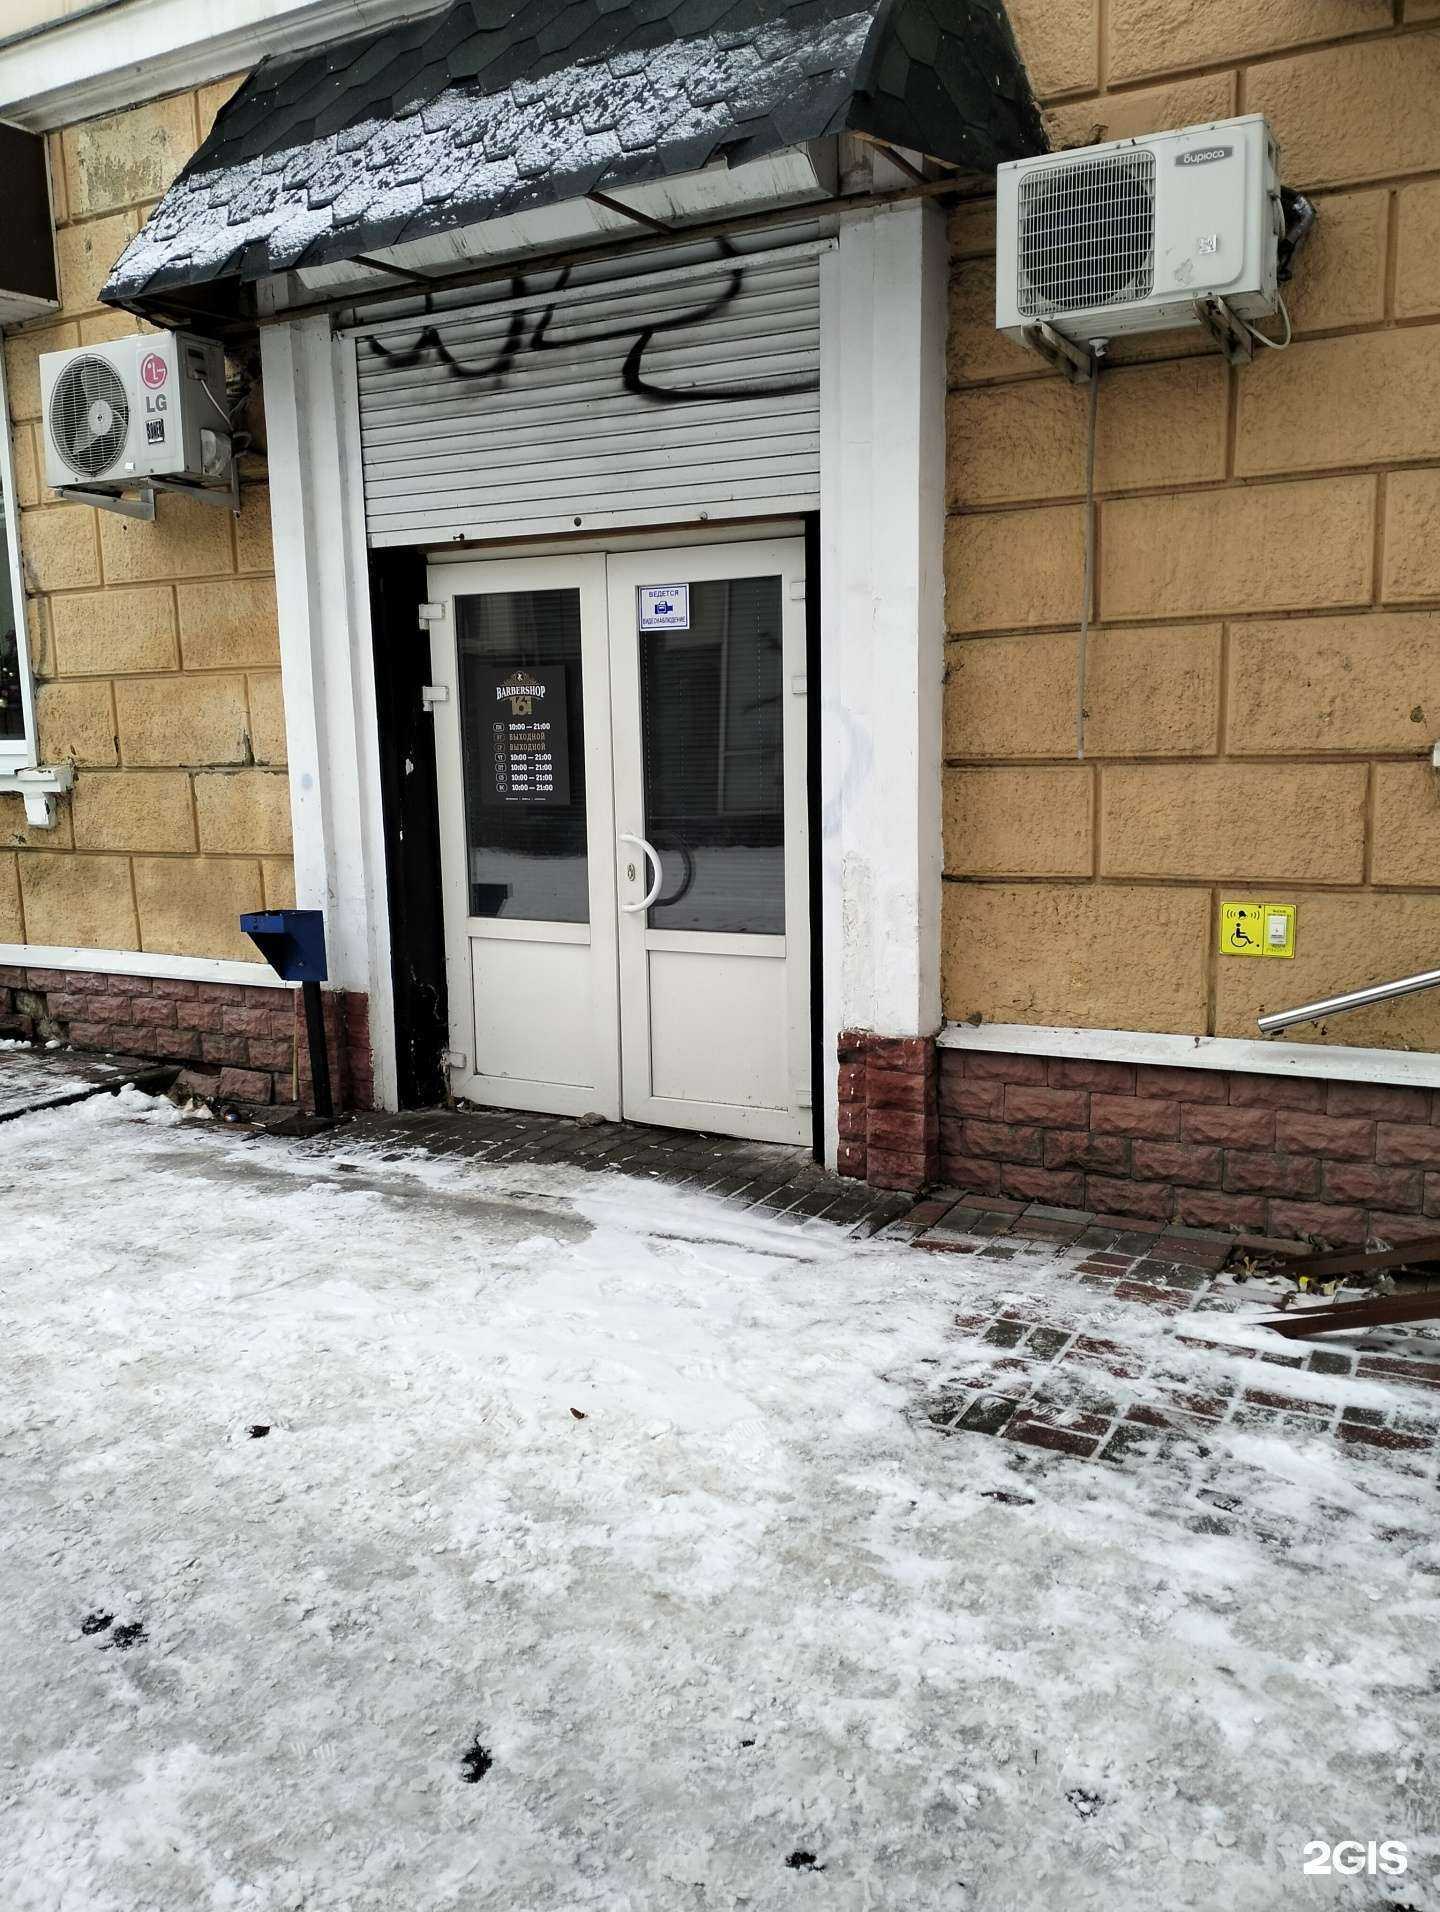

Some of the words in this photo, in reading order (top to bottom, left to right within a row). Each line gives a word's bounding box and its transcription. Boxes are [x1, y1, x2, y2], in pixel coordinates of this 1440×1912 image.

[145, 393, 168, 413] LG
[648, 590, 679, 598] ВЕДЕТСЯ
[496, 685, 546, 701] BARBERSHOP
[508, 723, 526, 731] 10:00
[533, 722, 551, 730] 21:00
[509, 732, 546, 742] ВЫХОДНОЙ
[509, 742, 546, 752] ВЫХОДНОЙ
[510, 753, 527, 761] 10:00
[534, 753, 552, 761] 21:00
[511, 763, 528, 771] 10:00
[535, 763, 553, 771] 21:00
[511, 773, 528, 781] 10:00
[535, 773, 553, 781] 21:00
[512, 783, 529, 791] 10:00
[536, 783, 554, 791] 21:00
